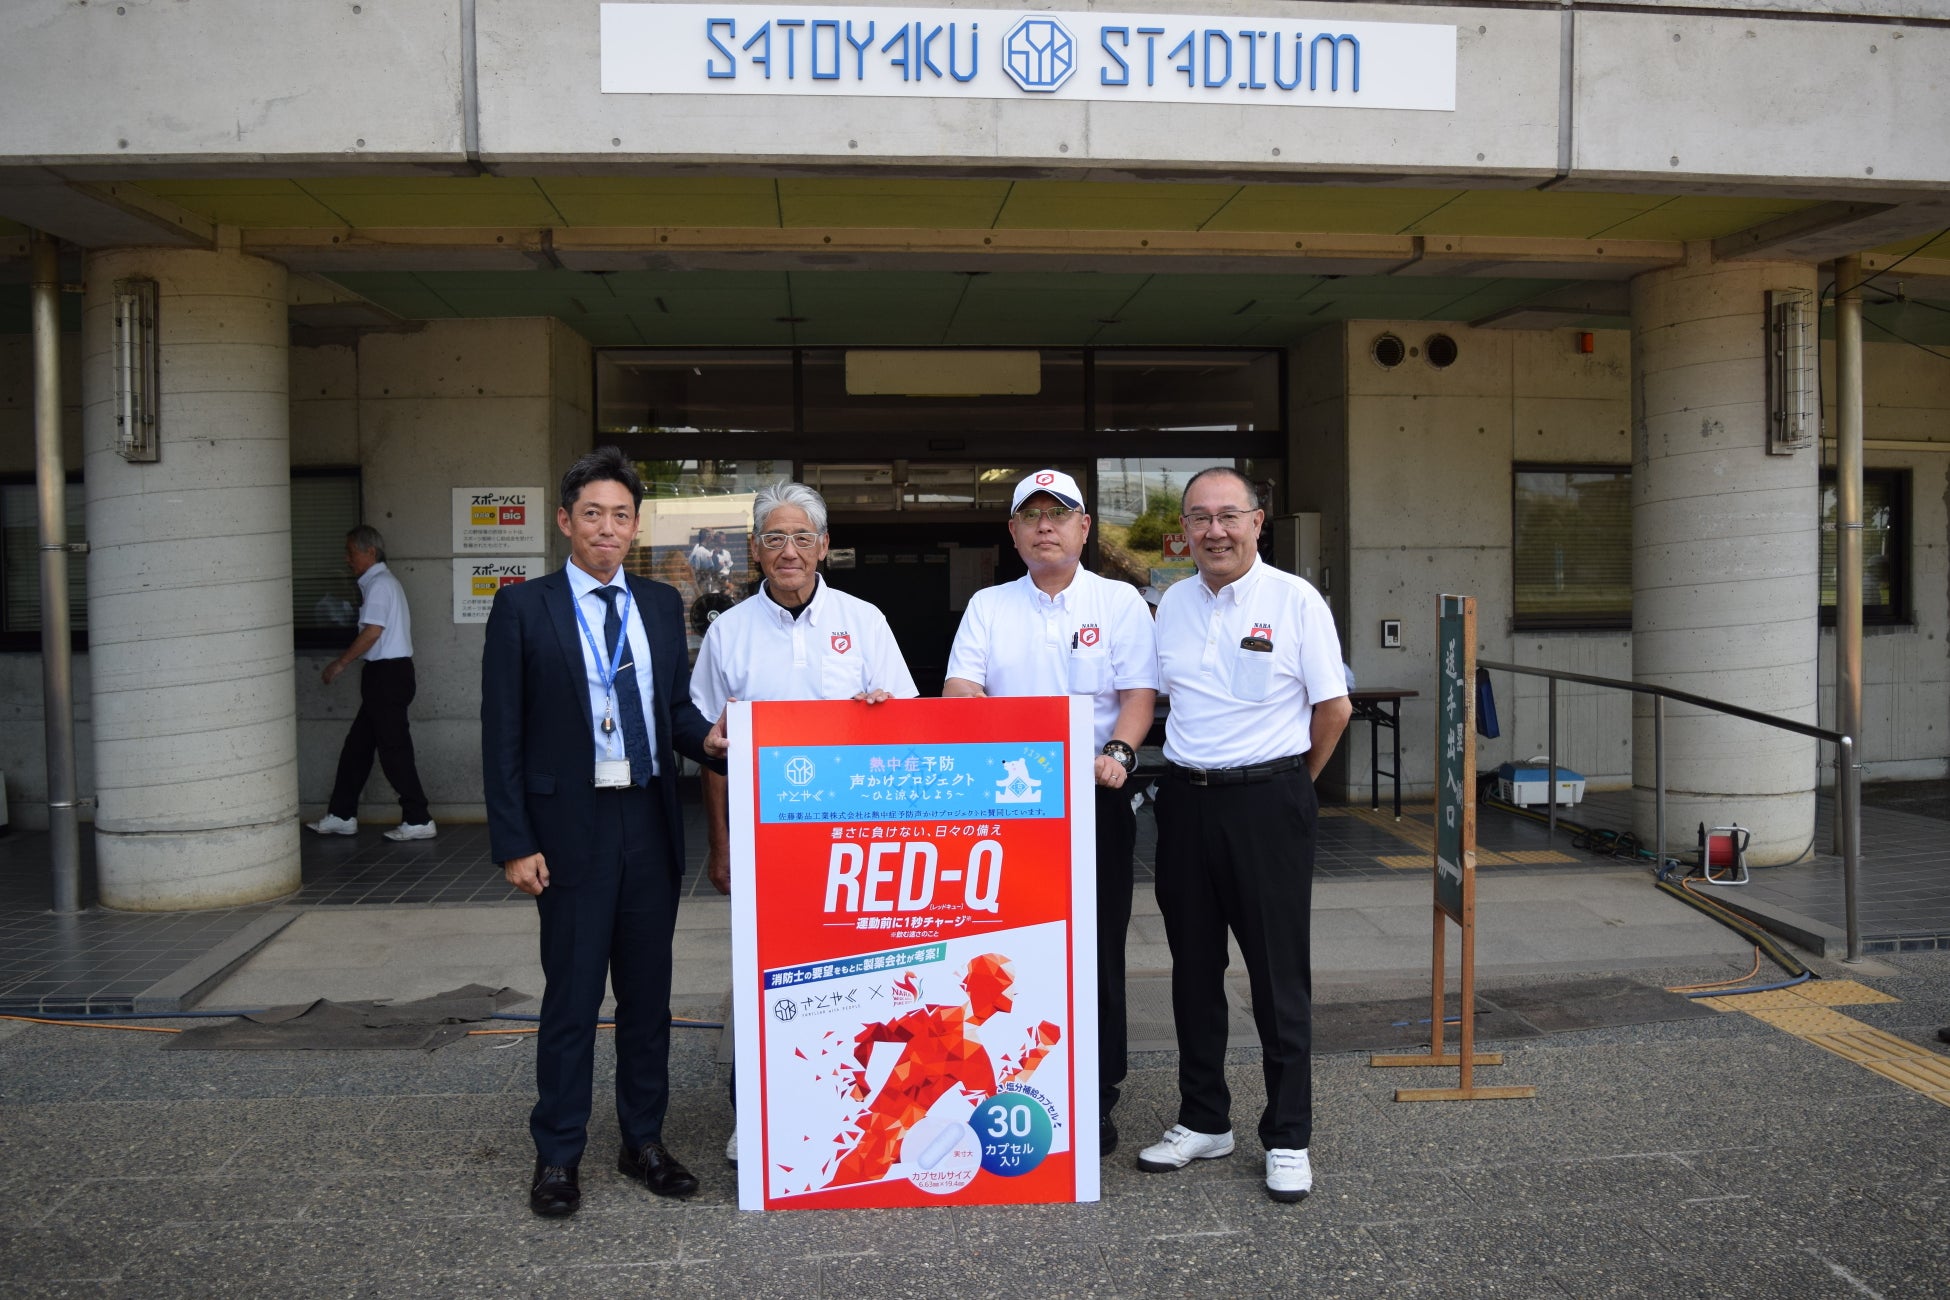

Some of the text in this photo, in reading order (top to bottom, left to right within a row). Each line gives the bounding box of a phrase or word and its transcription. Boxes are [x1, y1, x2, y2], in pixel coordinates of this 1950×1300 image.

[706, 17, 979, 82] SATOYAKU
[1100, 26, 1361, 92] STADIUM
[471, 493, 526, 505] スポーツくじ
[472, 563, 526, 575] スポーツくじ
[1445, 638, 1458, 829] 選手出入口
[869, 756, 955, 773] 熱中症予防
[849, 773, 975, 790] 声かけプロジェクト
[831, 824, 1002, 839] 暑さに負けない、日々の備え
[823, 839, 1004, 914] RED-Q
[1005, 1082, 1059, 1121] 塩分補給カプセル
[987, 1104, 1032, 1138] 30
[985, 1143, 1034, 1155] カプセル
[999, 1156, 1020, 1167] 入り
[912, 1170, 972, 1181] カプセルサイズ
